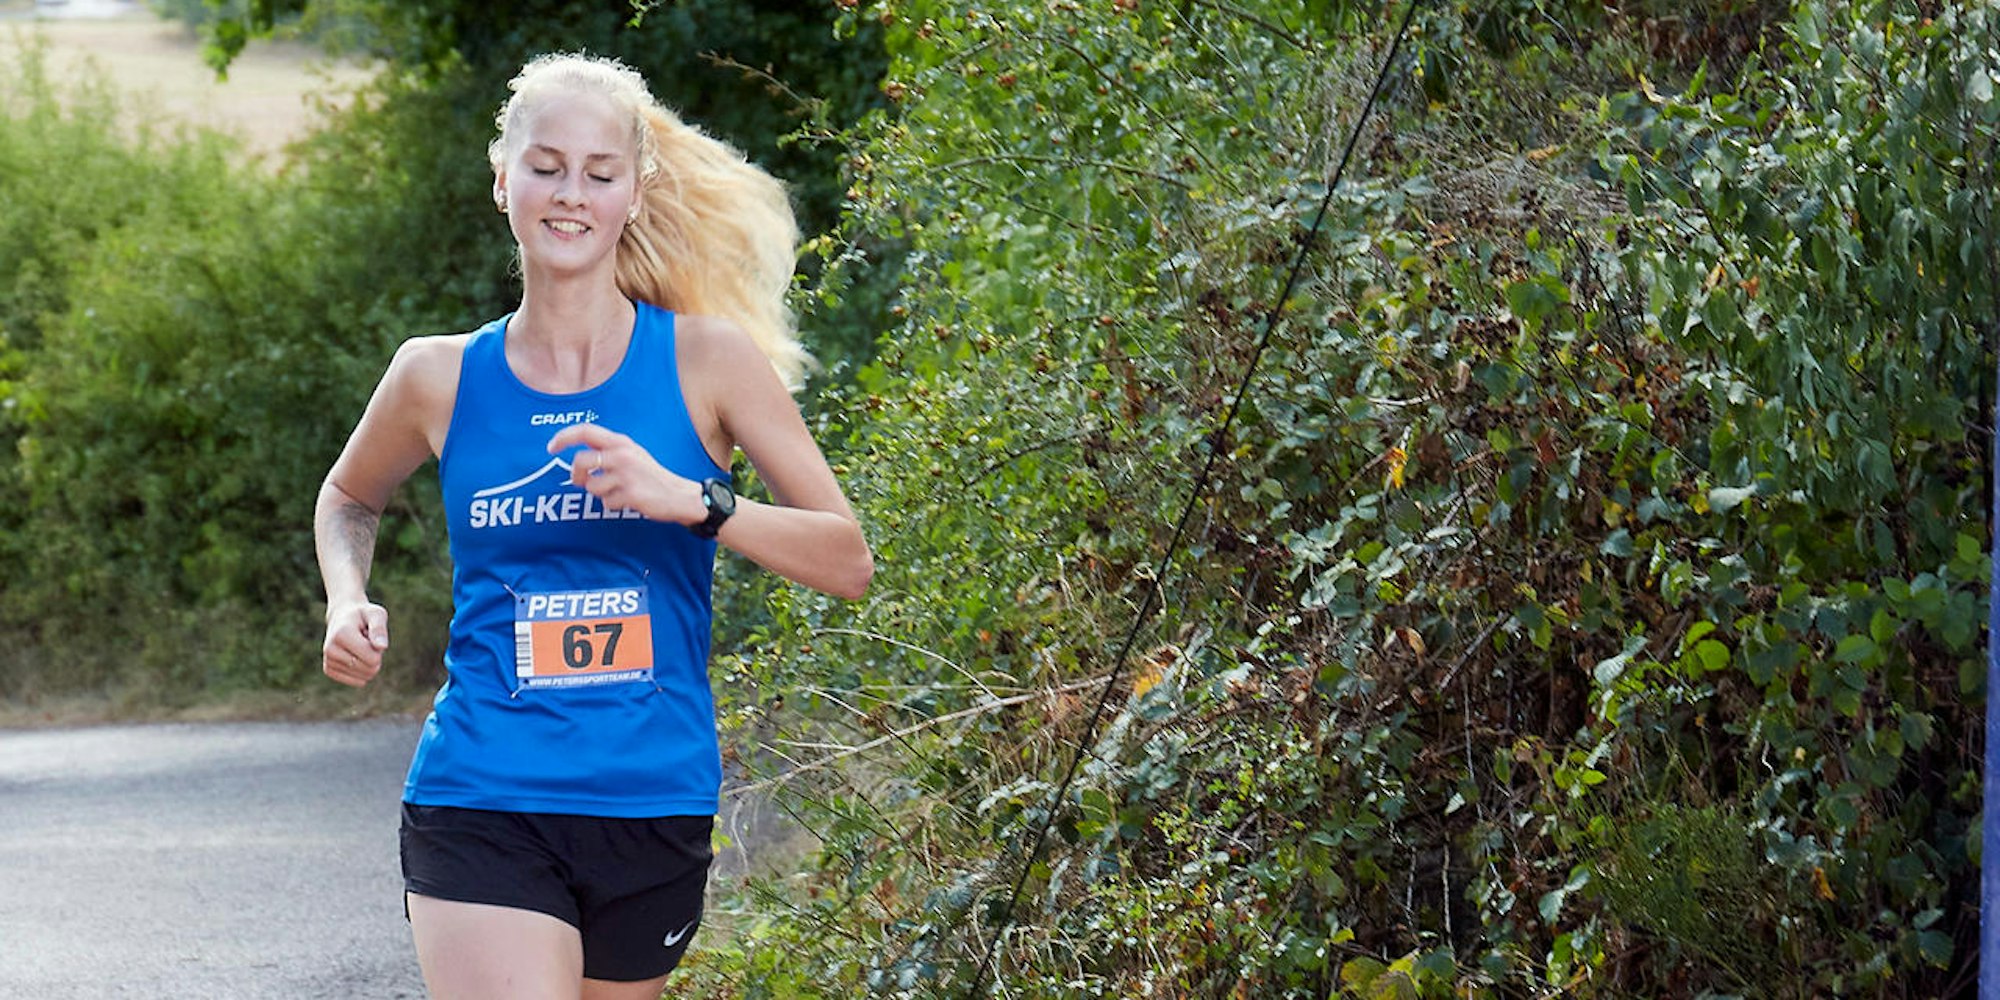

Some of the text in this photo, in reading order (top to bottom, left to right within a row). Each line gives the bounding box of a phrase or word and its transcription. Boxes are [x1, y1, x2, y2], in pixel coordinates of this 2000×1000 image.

[531, 411, 584, 425] CRAFT
[527, 590, 639, 618] PETERS
[562, 623, 623, 669] 67
